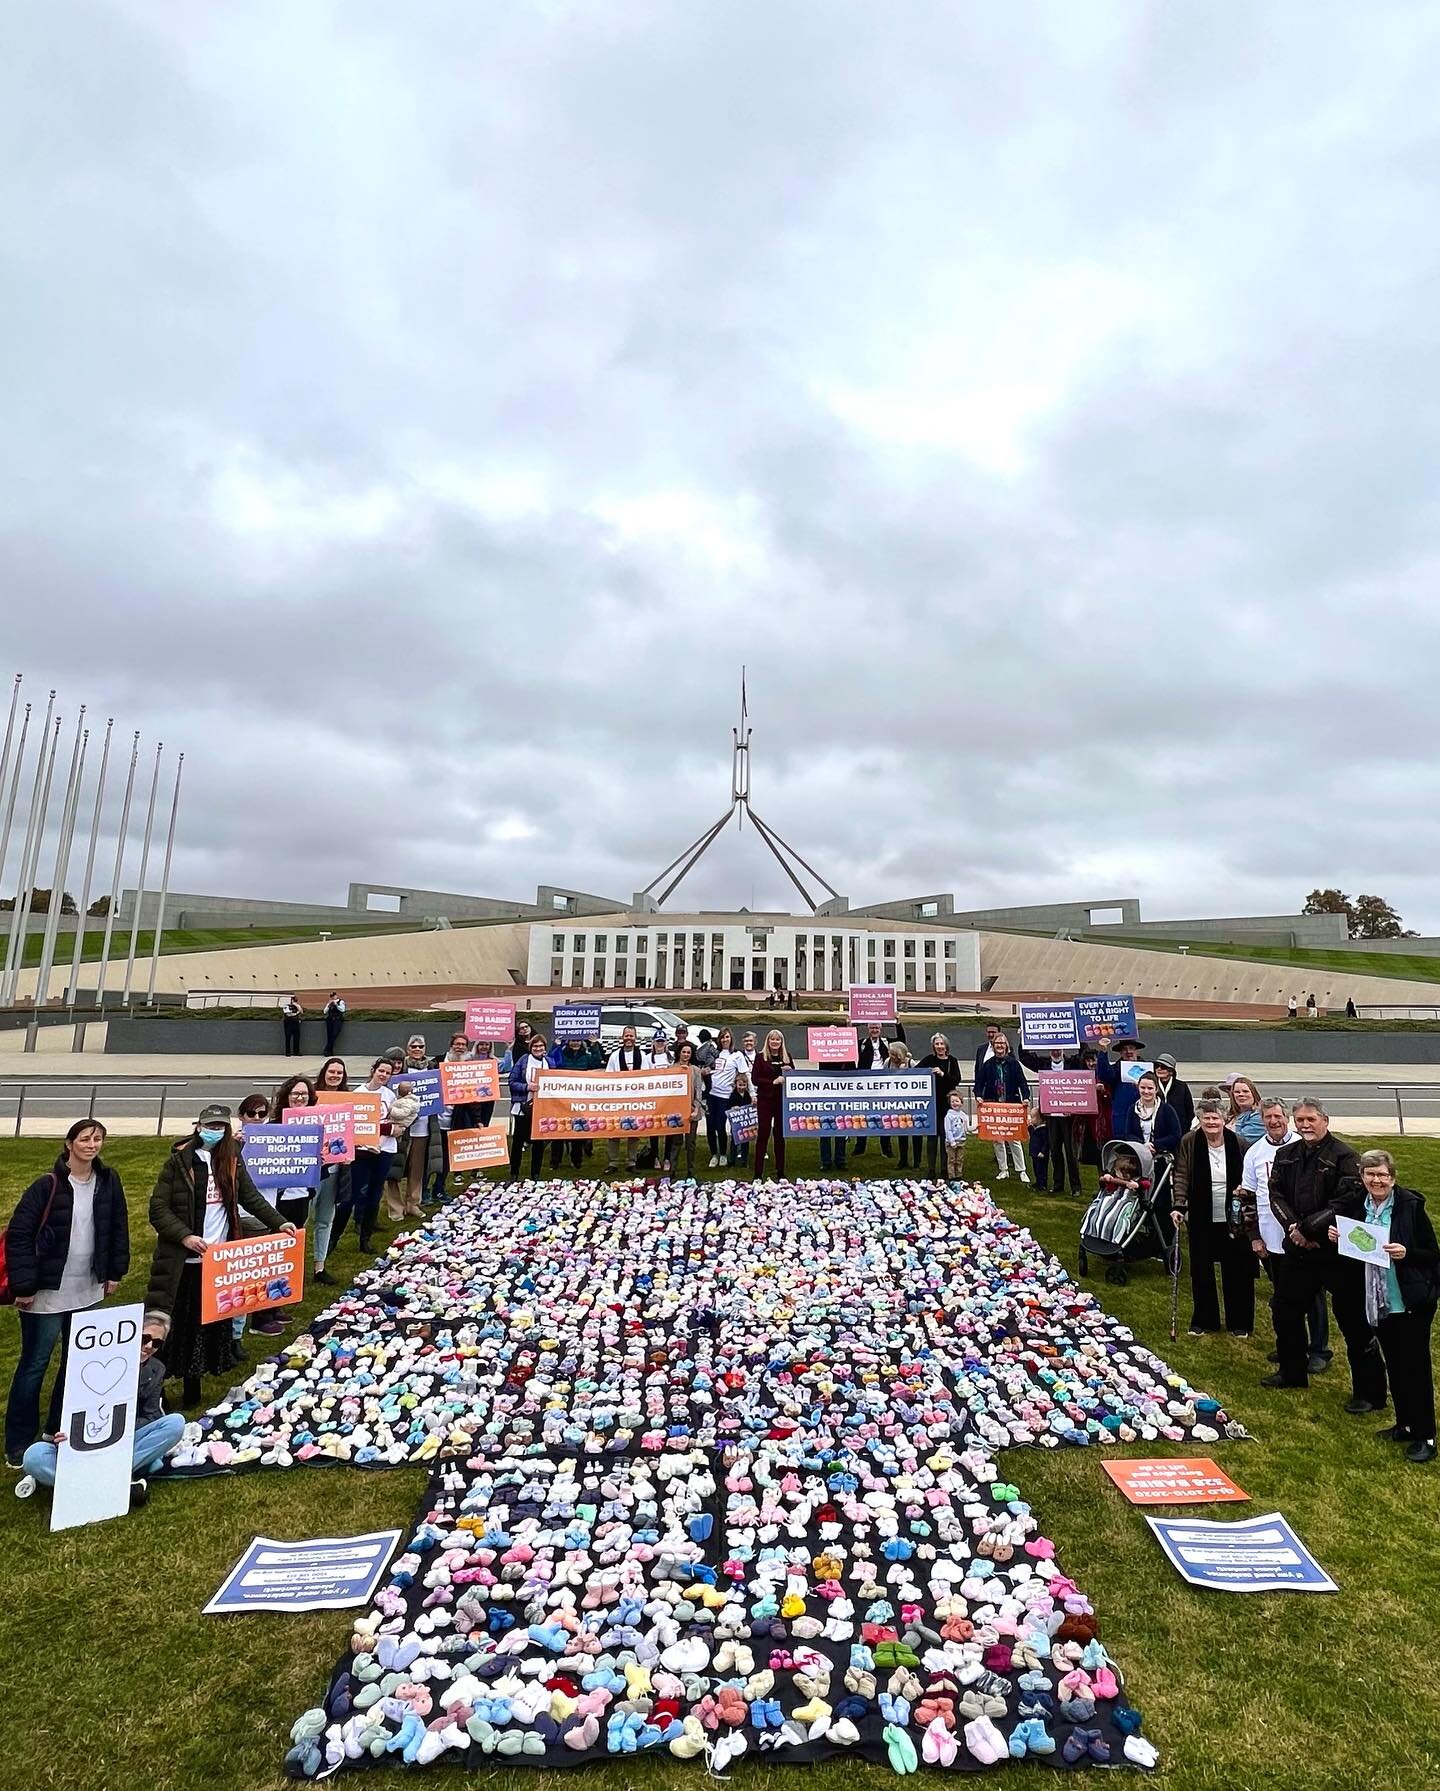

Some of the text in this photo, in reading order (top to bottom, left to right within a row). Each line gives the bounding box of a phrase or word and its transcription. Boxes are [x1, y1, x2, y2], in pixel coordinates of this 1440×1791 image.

[485, 1016, 511, 1024] BABIES
[445, 1064, 492, 1072] UNABORTED
[417, 1078, 438, 1086] BABIES
[447, 1077, 492, 1086] SUPPORTED
[543, 1080, 683, 1091] HUMAN RIGHTS FOR BABIES
[791, 1081, 928, 1091] BORN ALIVE & LEFT TO DIE
[570, 1101, 656, 1111] NO EXCEPTIONS!
[789, 1101, 930, 1111] PROTECT THEIR HUMANITY
[729, 1108, 748, 1117] EVERY
[288, 1112, 350, 1125] EVERY LIFE
[732, 1115, 744, 1123] HAS
[996, 1116, 1024, 1124] BABIES
[324, 1124, 346, 1134] TERS
[249, 1135, 319, 1144] DEFEND BABIES
[453, 1136, 478, 1145] HUMAN
[268, 1144, 301, 1152] RIGHTS
[248, 1157, 318, 1166] SUPPORT THEIR
[258, 1166, 308, 1175] HUMANITY
[213, 1237, 297, 1261] UNABORTED
[227, 1251, 284, 1272] MUST BE
[214, 1262, 294, 1288] SUPPORTED
[69, 1403, 127, 1452] U
[1126, 1478, 1226, 1488] 328 BABIES
[1207, 1488, 1235, 1496] QLD
[296, 1590, 320, 1598] need
[321, 1587, 340, 1595] you
